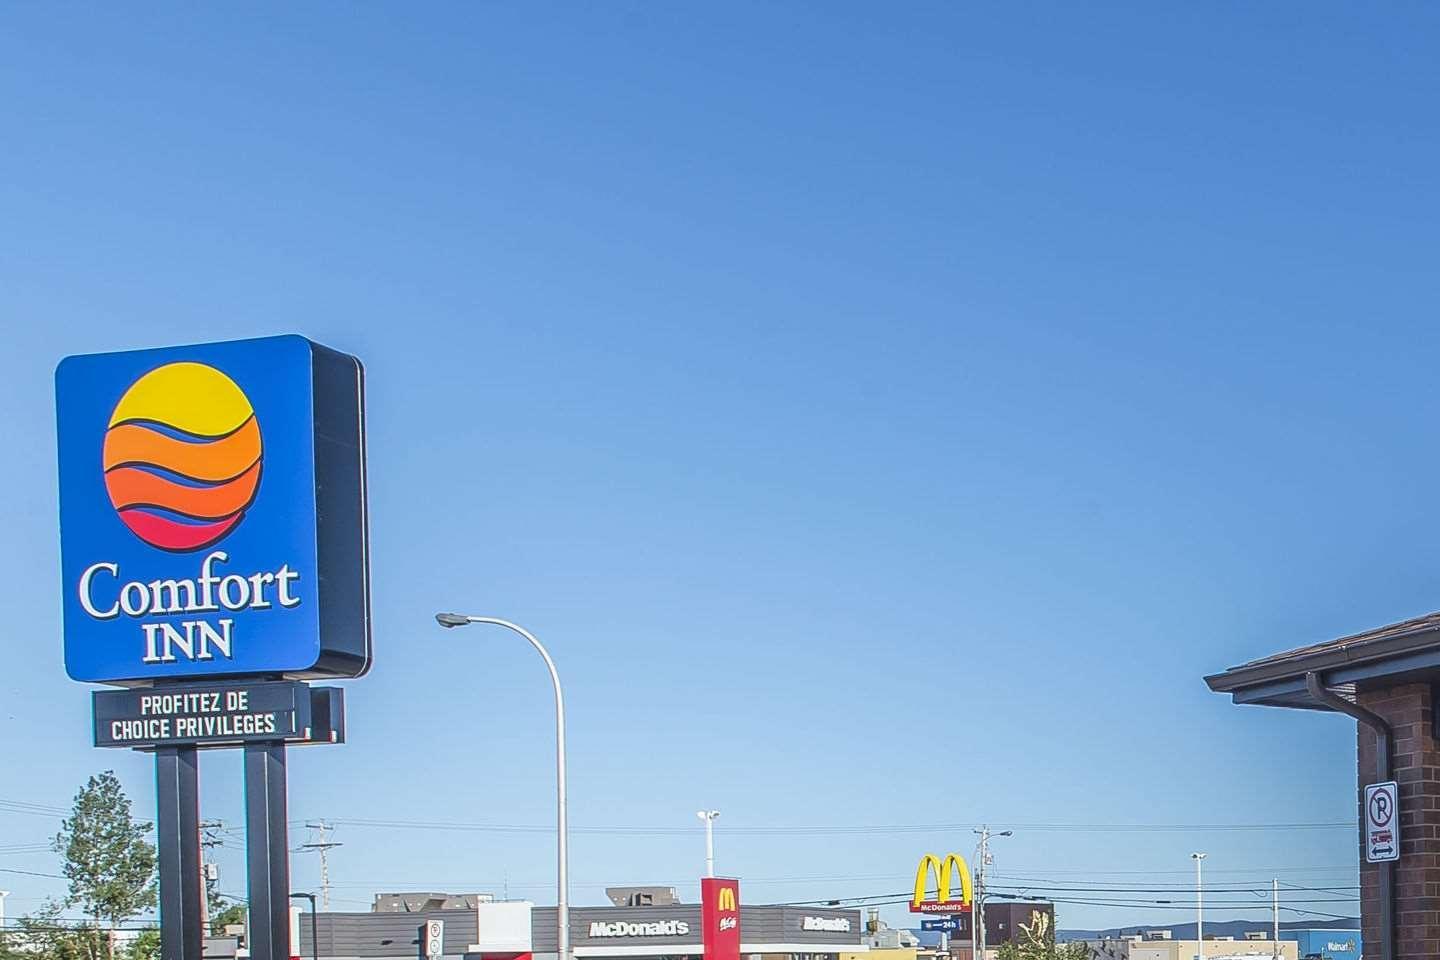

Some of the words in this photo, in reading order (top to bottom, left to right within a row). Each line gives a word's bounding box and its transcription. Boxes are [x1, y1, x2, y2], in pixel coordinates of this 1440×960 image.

[79, 551, 300, 620] Comfort
[141, 618, 233, 663] INN
[141, 693, 221, 715] PROFITEZ
[226, 691, 248, 711] DE
[111, 718, 170, 740] CHOICE
[176, 714, 275, 737] PRIVILEGES
[589, 920, 689, 937] McDonald's
